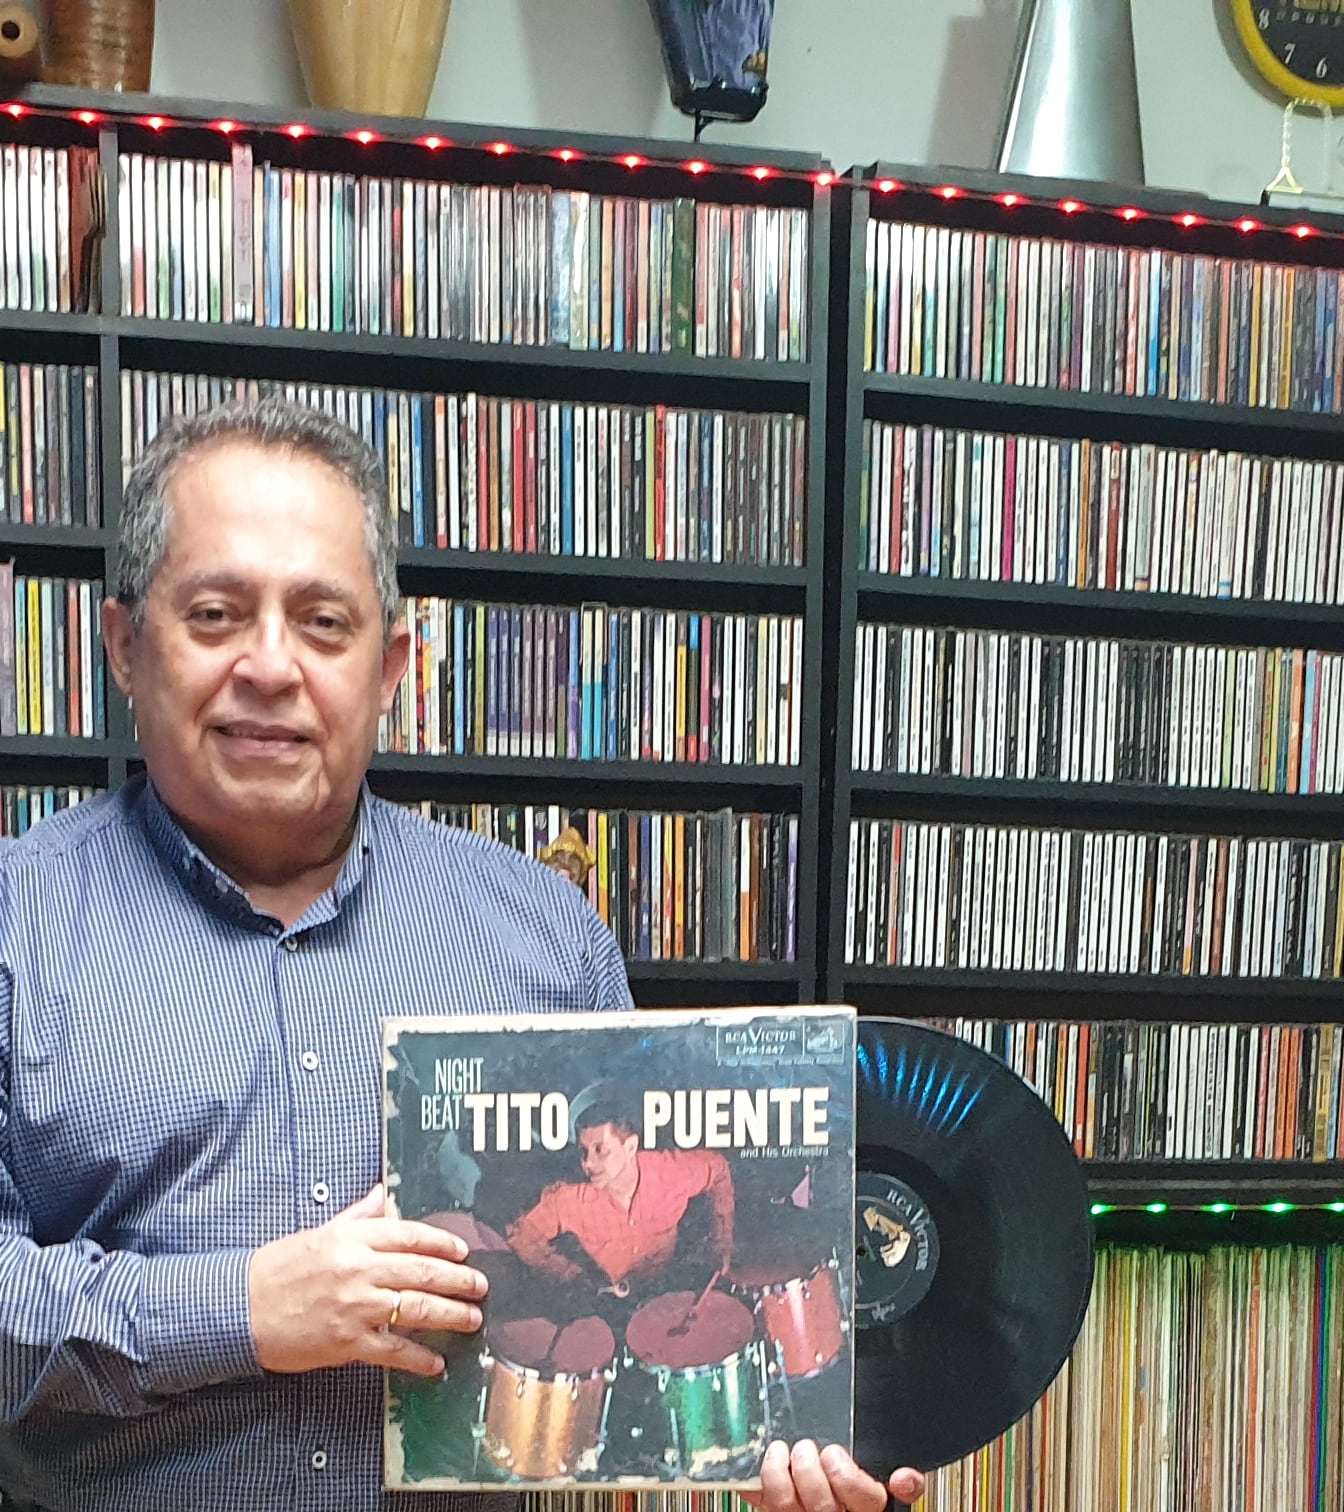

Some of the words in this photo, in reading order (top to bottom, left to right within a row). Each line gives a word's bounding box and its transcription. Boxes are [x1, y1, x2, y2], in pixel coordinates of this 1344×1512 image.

[1283, 42, 1296, 65] 7
[1315, 56, 1328, 79] 6
[434, 1057, 484, 1094] NIGHT
[421, 1094, 463, 1131] BEAT
[463, 1091, 570, 1153] TITO
[642, 1086, 830, 1149] PUENTE
[740, 1147, 759, 1160] and
[762, 1146, 778, 1159] His
[781, 1145, 829, 1158] Orchestra
